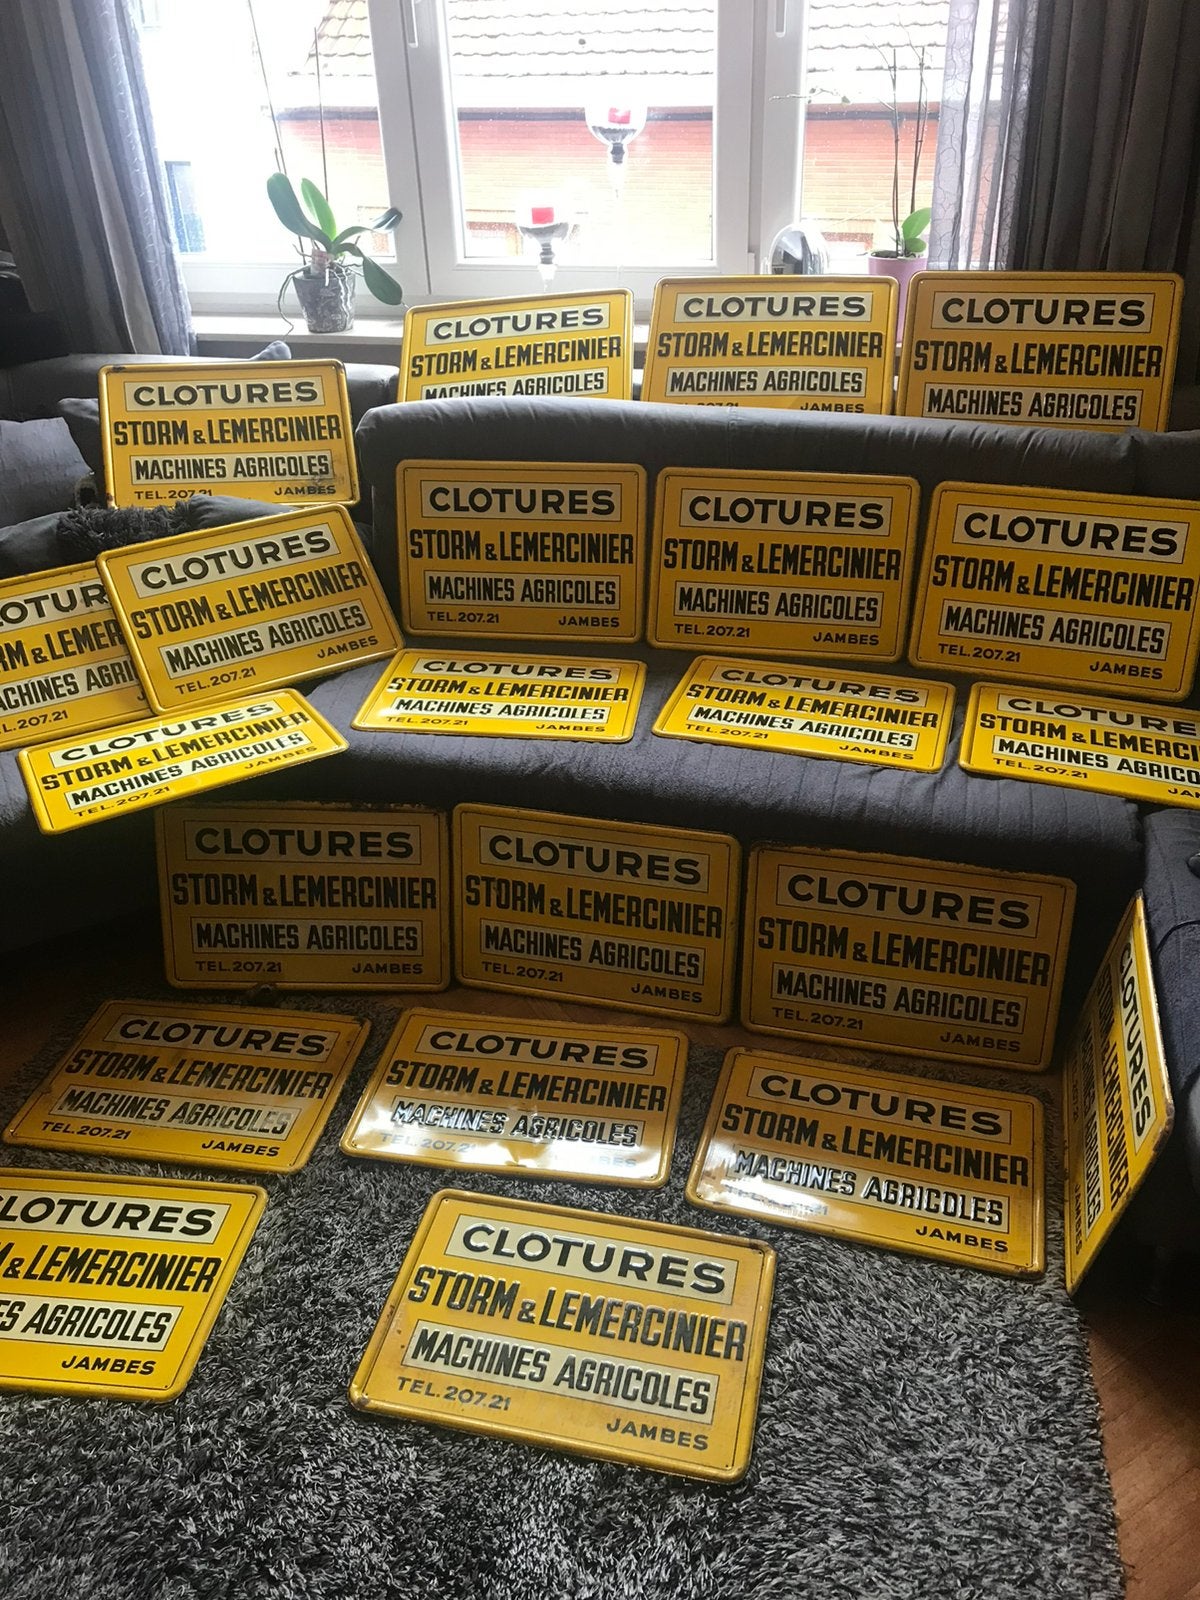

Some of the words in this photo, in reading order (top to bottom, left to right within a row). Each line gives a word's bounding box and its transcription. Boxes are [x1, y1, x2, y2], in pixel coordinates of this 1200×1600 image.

[434, 308, 604, 340] CLOTURES
[684, 297, 865, 318] CLOTURES
[942, 298, 1145, 326] CLOTURES
[410, 350, 479, 377] STORM
[482, 358, 494, 370] &
[496, 336, 620, 369] LEMERCINIER
[658, 333, 730, 357] STORM
[732, 343, 745, 357] &
[747, 332, 882, 357] LEMERCINIER
[914, 340, 992, 372] STORM
[994, 355, 1008, 373] &
[1010, 343, 1162, 377] LEMERCINIER
[134, 382, 318, 406] CLOTURES
[512, 372, 604, 395] AGRICOLES
[671, 372, 759, 392] MACHINES
[764, 372, 862, 393] AGRICOLES
[928, 388, 1023, 415] MACHINES
[1028, 392, 1137, 420] AGRICOLES
[114, 420, 188, 446] STORM
[193, 430, 206, 444] &
[207, 416, 342, 443] LEMERCINIER
[136, 458, 225, 479] MACHINES
[232, 454, 329, 477] AGRICOLES
[273, 485, 335, 495] JAMBES
[430, 487, 615, 515] CLOTURES
[690, 496, 883, 529] CLOTURES
[410, 529, 481, 560] STORM
[485, 544, 498, 561] &
[500, 531, 633, 564] LEMERCINIER
[964, 513, 1177, 555] CLOTURES
[142, 532, 330, 589] CLOTURES
[664, 538, 739, 571] STORM
[742, 555, 755, 572] &
[758, 543, 901, 580] LEMERCINIER
[429, 576, 514, 601] MACHINES
[521, 579, 615, 604] AGRICOLES
[932, 554, 1015, 592] STORM
[1016, 576, 1030, 594] &
[1033, 564, 1194, 610] LEMERCINIER
[131, 596, 216, 638] STORM
[216, 604, 234, 620] &
[227, 562, 367, 616] LEMERCINIER
[679, 587, 770, 615] MACHINES
[775, 593, 878, 622] AGRICOLES
[166, 630, 264, 672] MACHINES
[268, 606, 366, 648] AGRICOLES
[559, 616, 619, 627] JAMBES
[814, 632, 879, 646] JAMBES
[945, 605, 1045, 640] MACHINES
[1049, 617, 1165, 654] AGRICOLES
[318, 636, 378, 659] JAMBES
[423, 661, 612, 680] CLOTURES
[722, 670, 919, 702] CLOTURES
[1090, 662, 1163, 680] JAMBES
[388, 678, 471, 694] STORM
[469, 686, 480, 695] &
[484, 682, 629, 701] LEMERCINIER
[686, 684, 768, 706] STORM
[768, 700, 781, 709] &
[784, 696, 938, 729] LEMERCINIER
[396, 700, 493, 715] MACHINES
[498, 704, 605, 720] AGRICOLES
[694, 707, 794, 731] MACHINES
[798, 721, 913, 747] AGRICOLES
[1008, 698, 1196, 736] CLOTURE
[62, 704, 274, 761] CLOTURES
[536, 724, 605, 732] JAMBES
[981, 713, 1066, 740] STORM
[1072, 733, 1086, 744] &
[1090, 729, 1200, 762] LEMERCI
[41, 755, 130, 790] STORM
[137, 756, 153, 766] &
[152, 712, 311, 762] LEMERCINIER
[245, 746, 318, 770] JAMBES
[840, 746, 914, 760] JAMBES
[999, 739, 1109, 768] MACHINES
[1117, 758, 1200, 784] AGRICO
[72, 765, 183, 806] MACHINES
[192, 733, 303, 772] AGRICOLES
[196, 828, 413, 858] CLOTURES
[490, 835, 701, 885] CLOTURES
[172, 873, 258, 905] STORM
[264, 888, 279, 906] &
[281, 875, 437, 908] LEMERCINIER
[466, 874, 545, 914] STORM
[551, 899, 565, 917] &
[568, 888, 721, 938] LEMERCINIER
[788, 875, 1030, 928] CLOTURES
[197, 923, 300, 949] MACHINES
[308, 925, 418, 951] AGRICOLES
[486, 925, 583, 961] MACHINES
[590, 940, 700, 978] AGRICOLES
[758, 916, 849, 959] STORM
[853, 942, 869, 962] &
[872, 931, 1050, 986] LEMERCINIER
[353, 964, 424, 975] JAMBES
[633, 984, 703, 1003] JAMBES
[777, 969, 887, 1008] MACHINES
[894, 986, 1021, 1027] AGRICOLES
[120, 1020, 327, 1055] CLOTURES
[431, 1032, 648, 1068] CLOTURES
[941, 1032, 1021, 1053] JAMBES
[1120, 943, 1150, 1136] CLOTURES
[66, 1050, 159, 1081] STORM
[150, 1068, 168, 1083] &
[167, 1059, 334, 1099] LEMERCINIER
[388, 1061, 482, 1092] STORM
[482, 1080, 497, 1094] &
[500, 1071, 666, 1110] LEMERCINIER
[58, 1090, 170, 1121] MACHINES
[167, 1102, 293, 1135] AGRICOLES
[762, 1076, 1002, 1135] CLOTURES
[390, 1101, 507, 1134] MACHINES
[511, 1115, 638, 1147] AGRICOLES
[202, 1141, 281, 1158] JAMBES
[722, 1104, 819, 1147] STORM
[821, 1133, 837, 1151] &
[841, 1126, 1029, 1188] LEMERCINIER
[734, 1150, 856, 1195] MACHINES
[862, 1176, 1003, 1226] AGRICOLES
[0, 1195, 216, 1236] LOTURES
[916, 1226, 1009, 1253] JAMBES
[23, 1244, 222, 1292] LEMERCINIER
[464, 1226, 724, 1293] CLOTURES
[22, 1303, 172, 1343] AGRICOLES
[408, 1266, 522, 1320] STORM
[519, 1301, 537, 1324] &
[540, 1289, 747, 1362] LEMERCINIER
[62, 1356, 156, 1375] JAMBES
[412, 1329, 552, 1384] MACHINES
[555, 1356, 711, 1415] AGRICOLES
[608, 1420, 709, 1452] JAMBES
